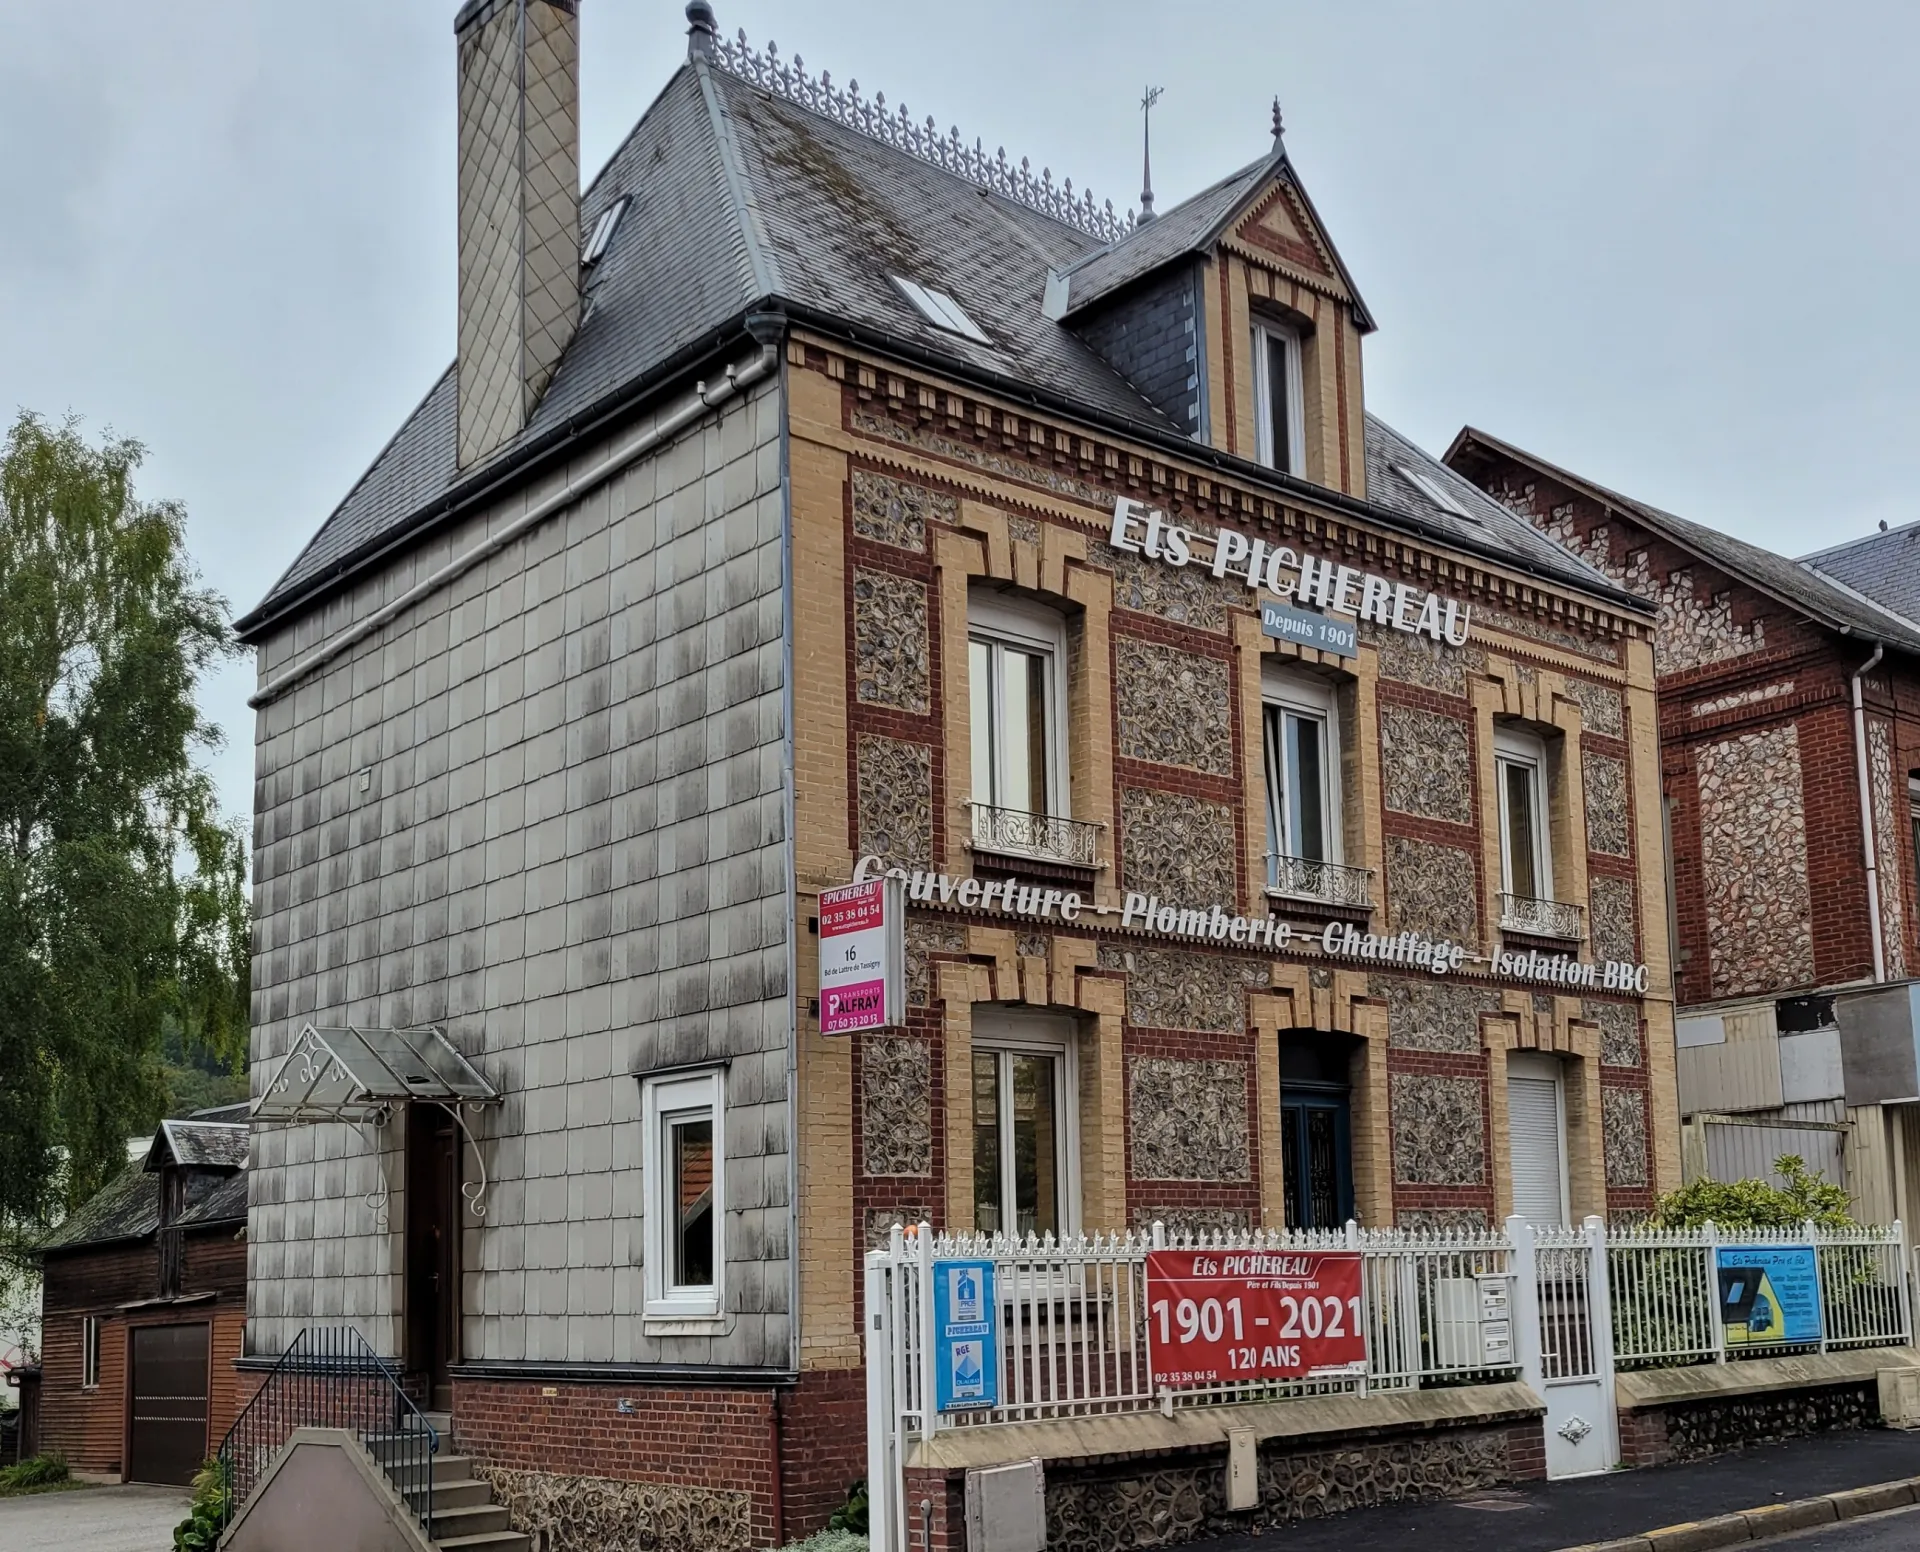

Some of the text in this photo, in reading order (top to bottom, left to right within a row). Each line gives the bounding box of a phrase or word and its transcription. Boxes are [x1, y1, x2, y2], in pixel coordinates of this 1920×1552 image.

[1110, 495, 1471, 646] Ets PICHEREAU
[1264, 608, 1355, 649] Depuis 1901
[827, 883, 876, 904] PICHEREAU
[822, 904, 880, 925] 02 35 38 04 54
[1121, 892, 1292, 948] Plomberie
[1322, 921, 1464, 974] Chauffage
[1491, 944, 1595, 985] Isolation
[1603, 960, 1650, 993] BBC
[844, 945, 856, 962] 16
[838, 965, 853, 974] Lattre
[853, 963, 860, 971] de
[860, 960, 880, 970] Tassigny
[840, 986, 880, 999] TRANSPORTS
[828, 994, 880, 1016] PALFRAY
[828, 1020, 837, 1031] 07
[838, 1017, 848, 1027] 60
[849, 1017, 858, 1029] 33
[859, 1014, 868, 1024] 20
[1192, 1255, 1314, 1276] Ets PICHEREAU
[1246, 1280, 1320, 1290] Père et Fils Depuis 1901
[1152, 1297, 1244, 1344] 1901
[1279, 1296, 1363, 1338] 2021
[955, 1344, 971, 1357] RGE
[1227, 1345, 1300, 1370] 120 ANS
[1155, 1370, 1217, 1382] 02 35 38 04 54
